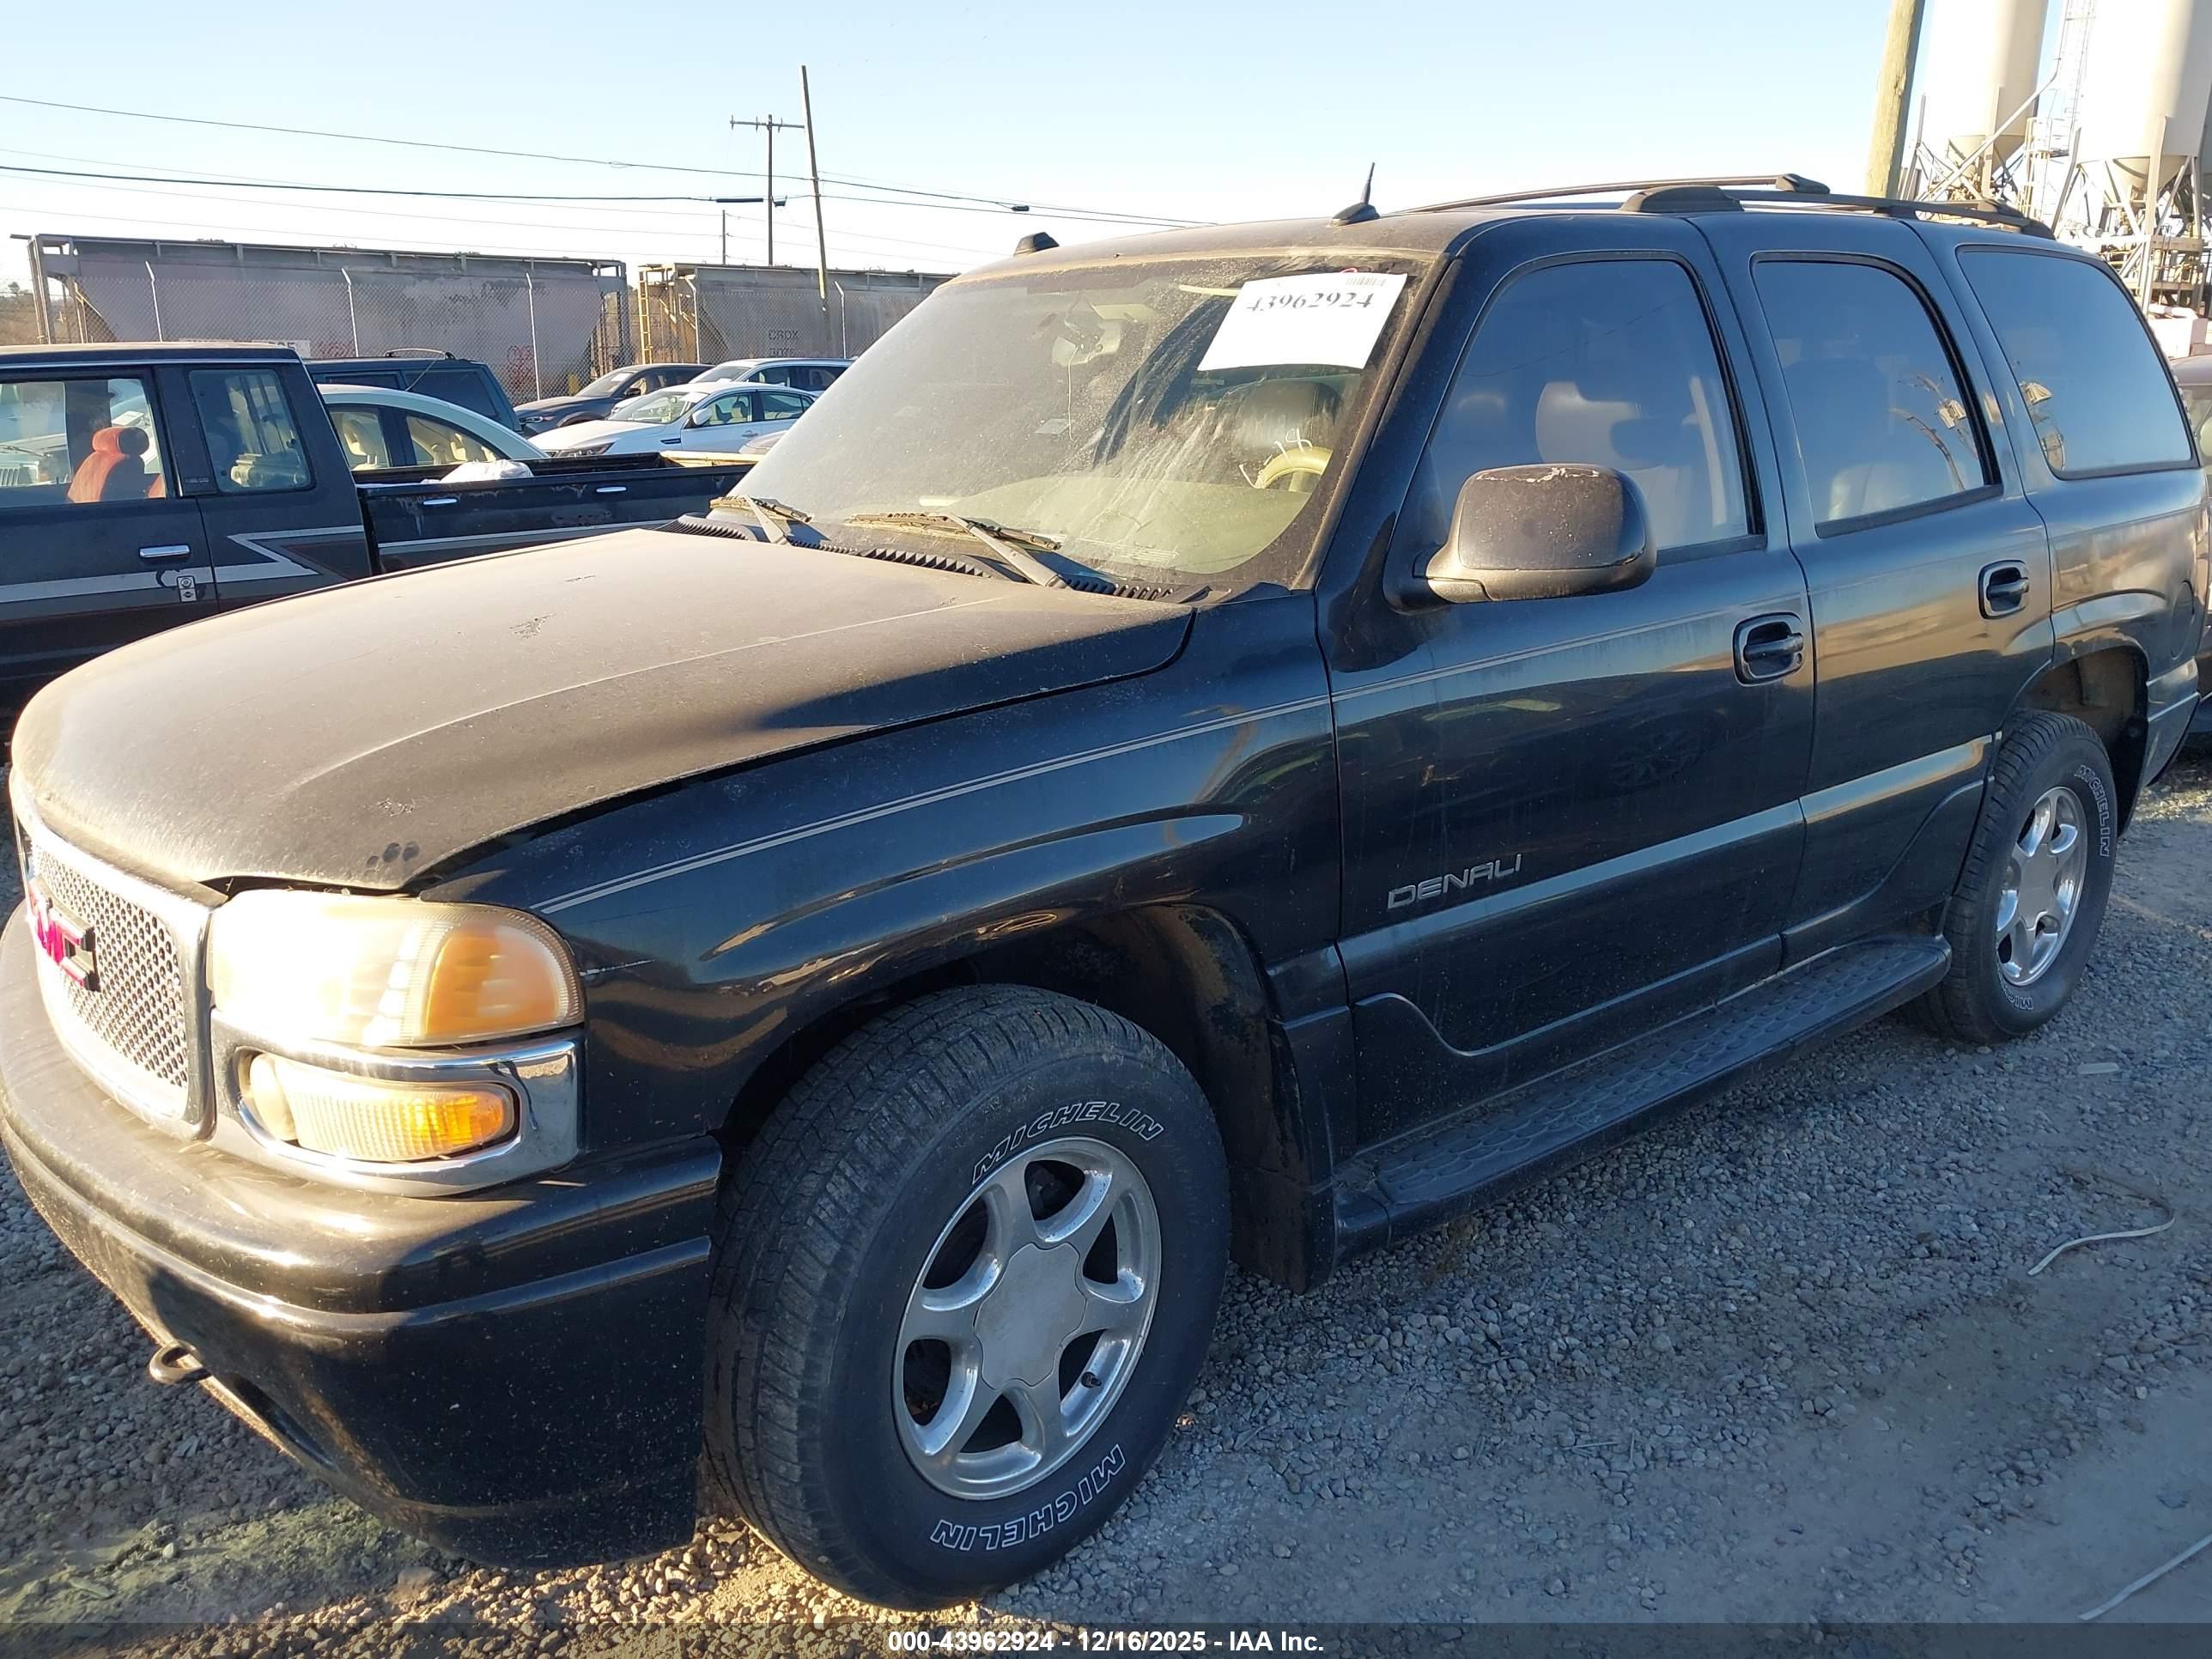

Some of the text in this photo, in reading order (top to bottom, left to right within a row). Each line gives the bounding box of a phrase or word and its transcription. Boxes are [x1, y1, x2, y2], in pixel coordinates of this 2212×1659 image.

[1246, 292, 1374, 312] 43962924
[2074, 764, 2110, 857] MICHELIN
[1387, 854, 1522, 909] DENALI
[972, 1101, 1164, 1185] MICHELIN
[930, 1443, 1126, 1551] MICHELIN
